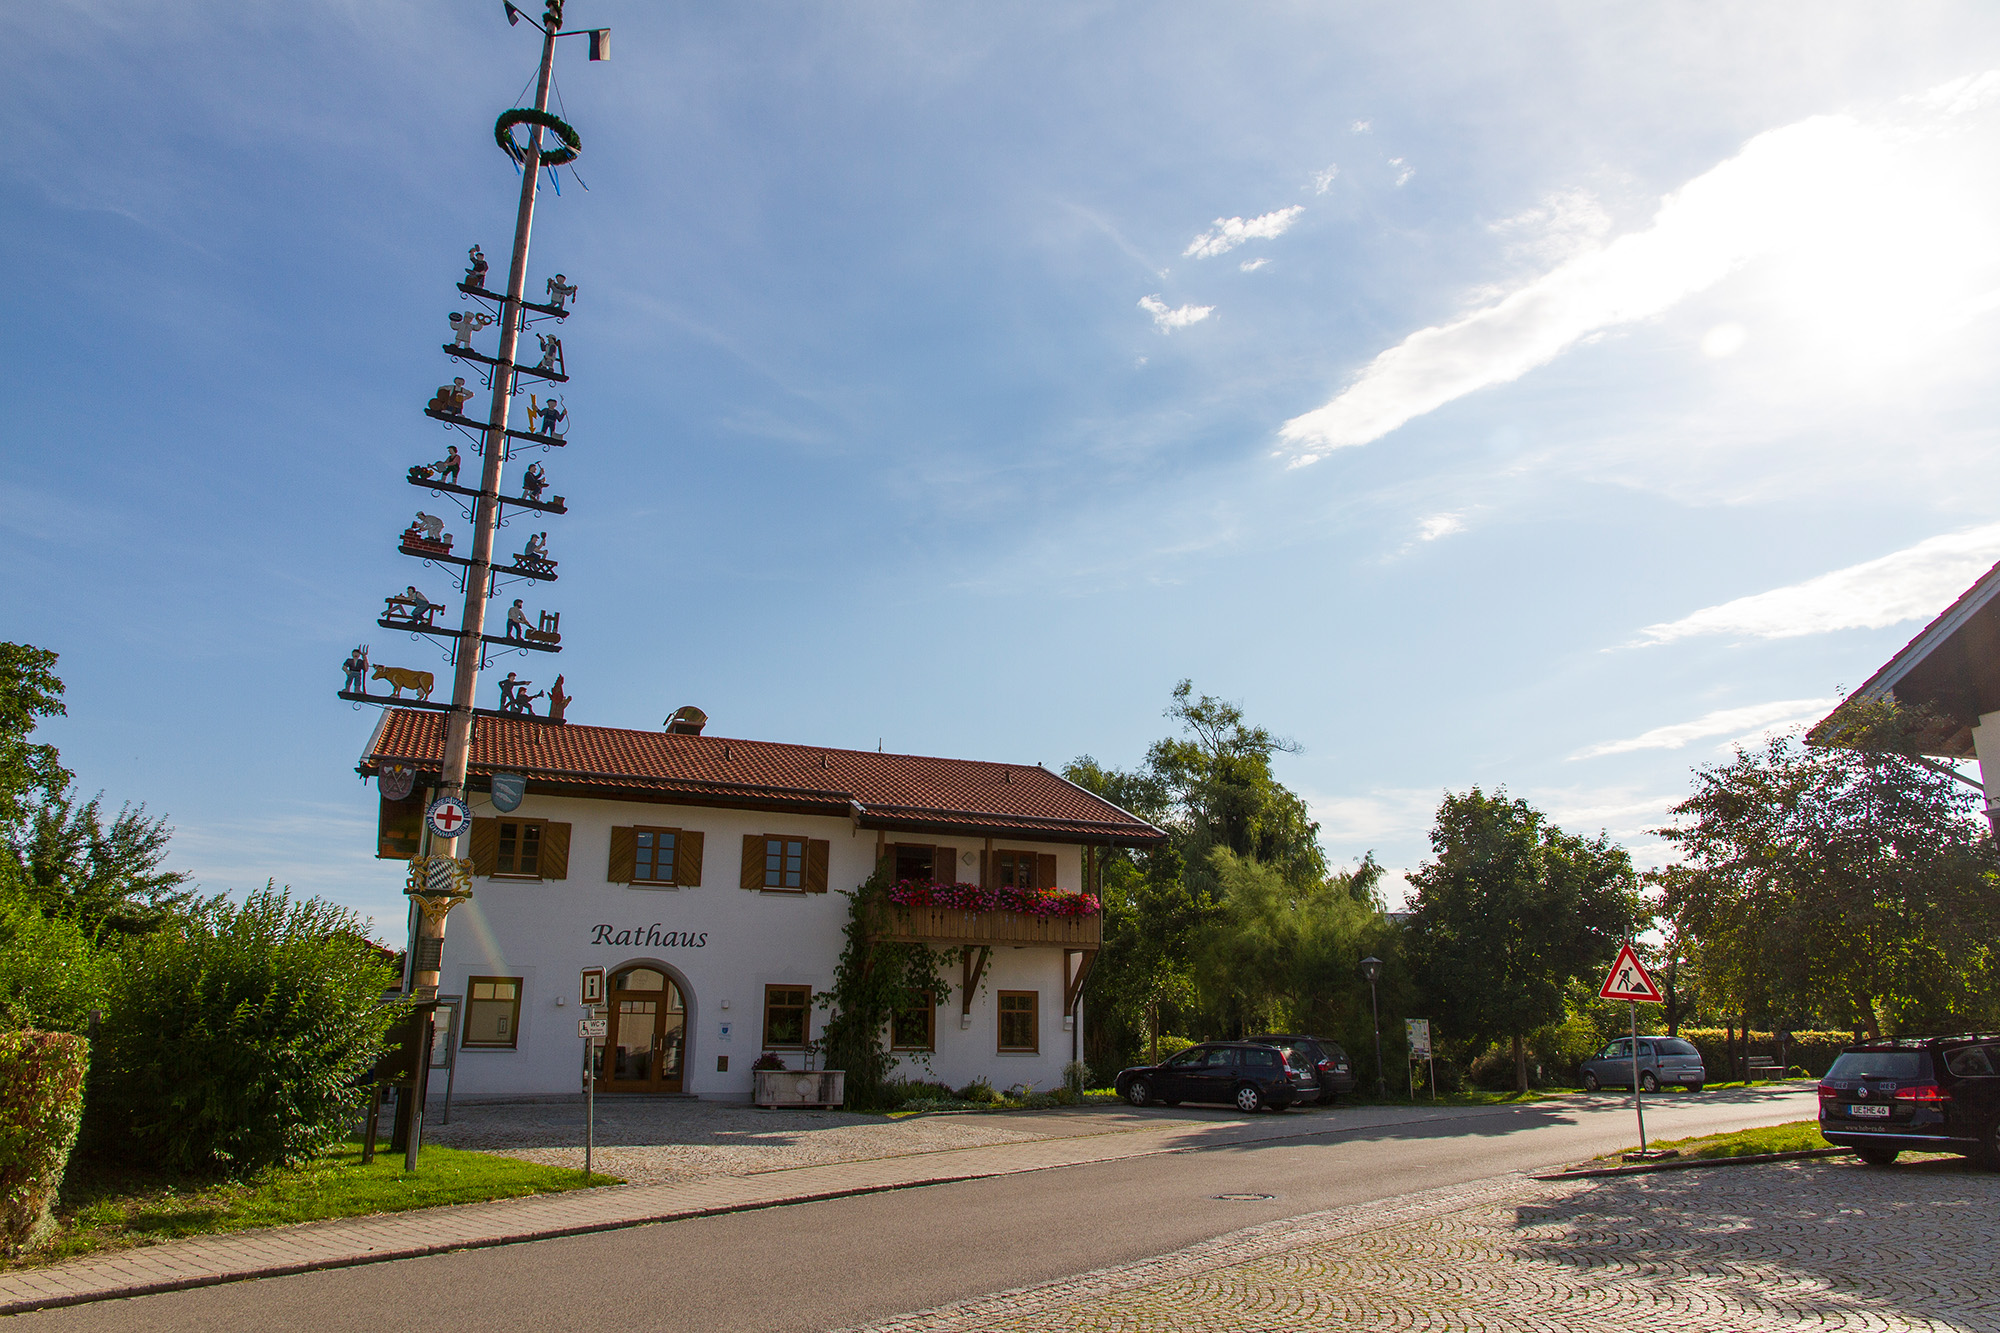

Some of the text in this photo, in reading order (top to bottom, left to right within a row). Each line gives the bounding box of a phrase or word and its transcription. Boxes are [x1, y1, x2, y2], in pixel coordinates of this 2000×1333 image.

[428, 798, 470, 818] WASSER WACHT
[591, 923, 708, 947] Rathaus
